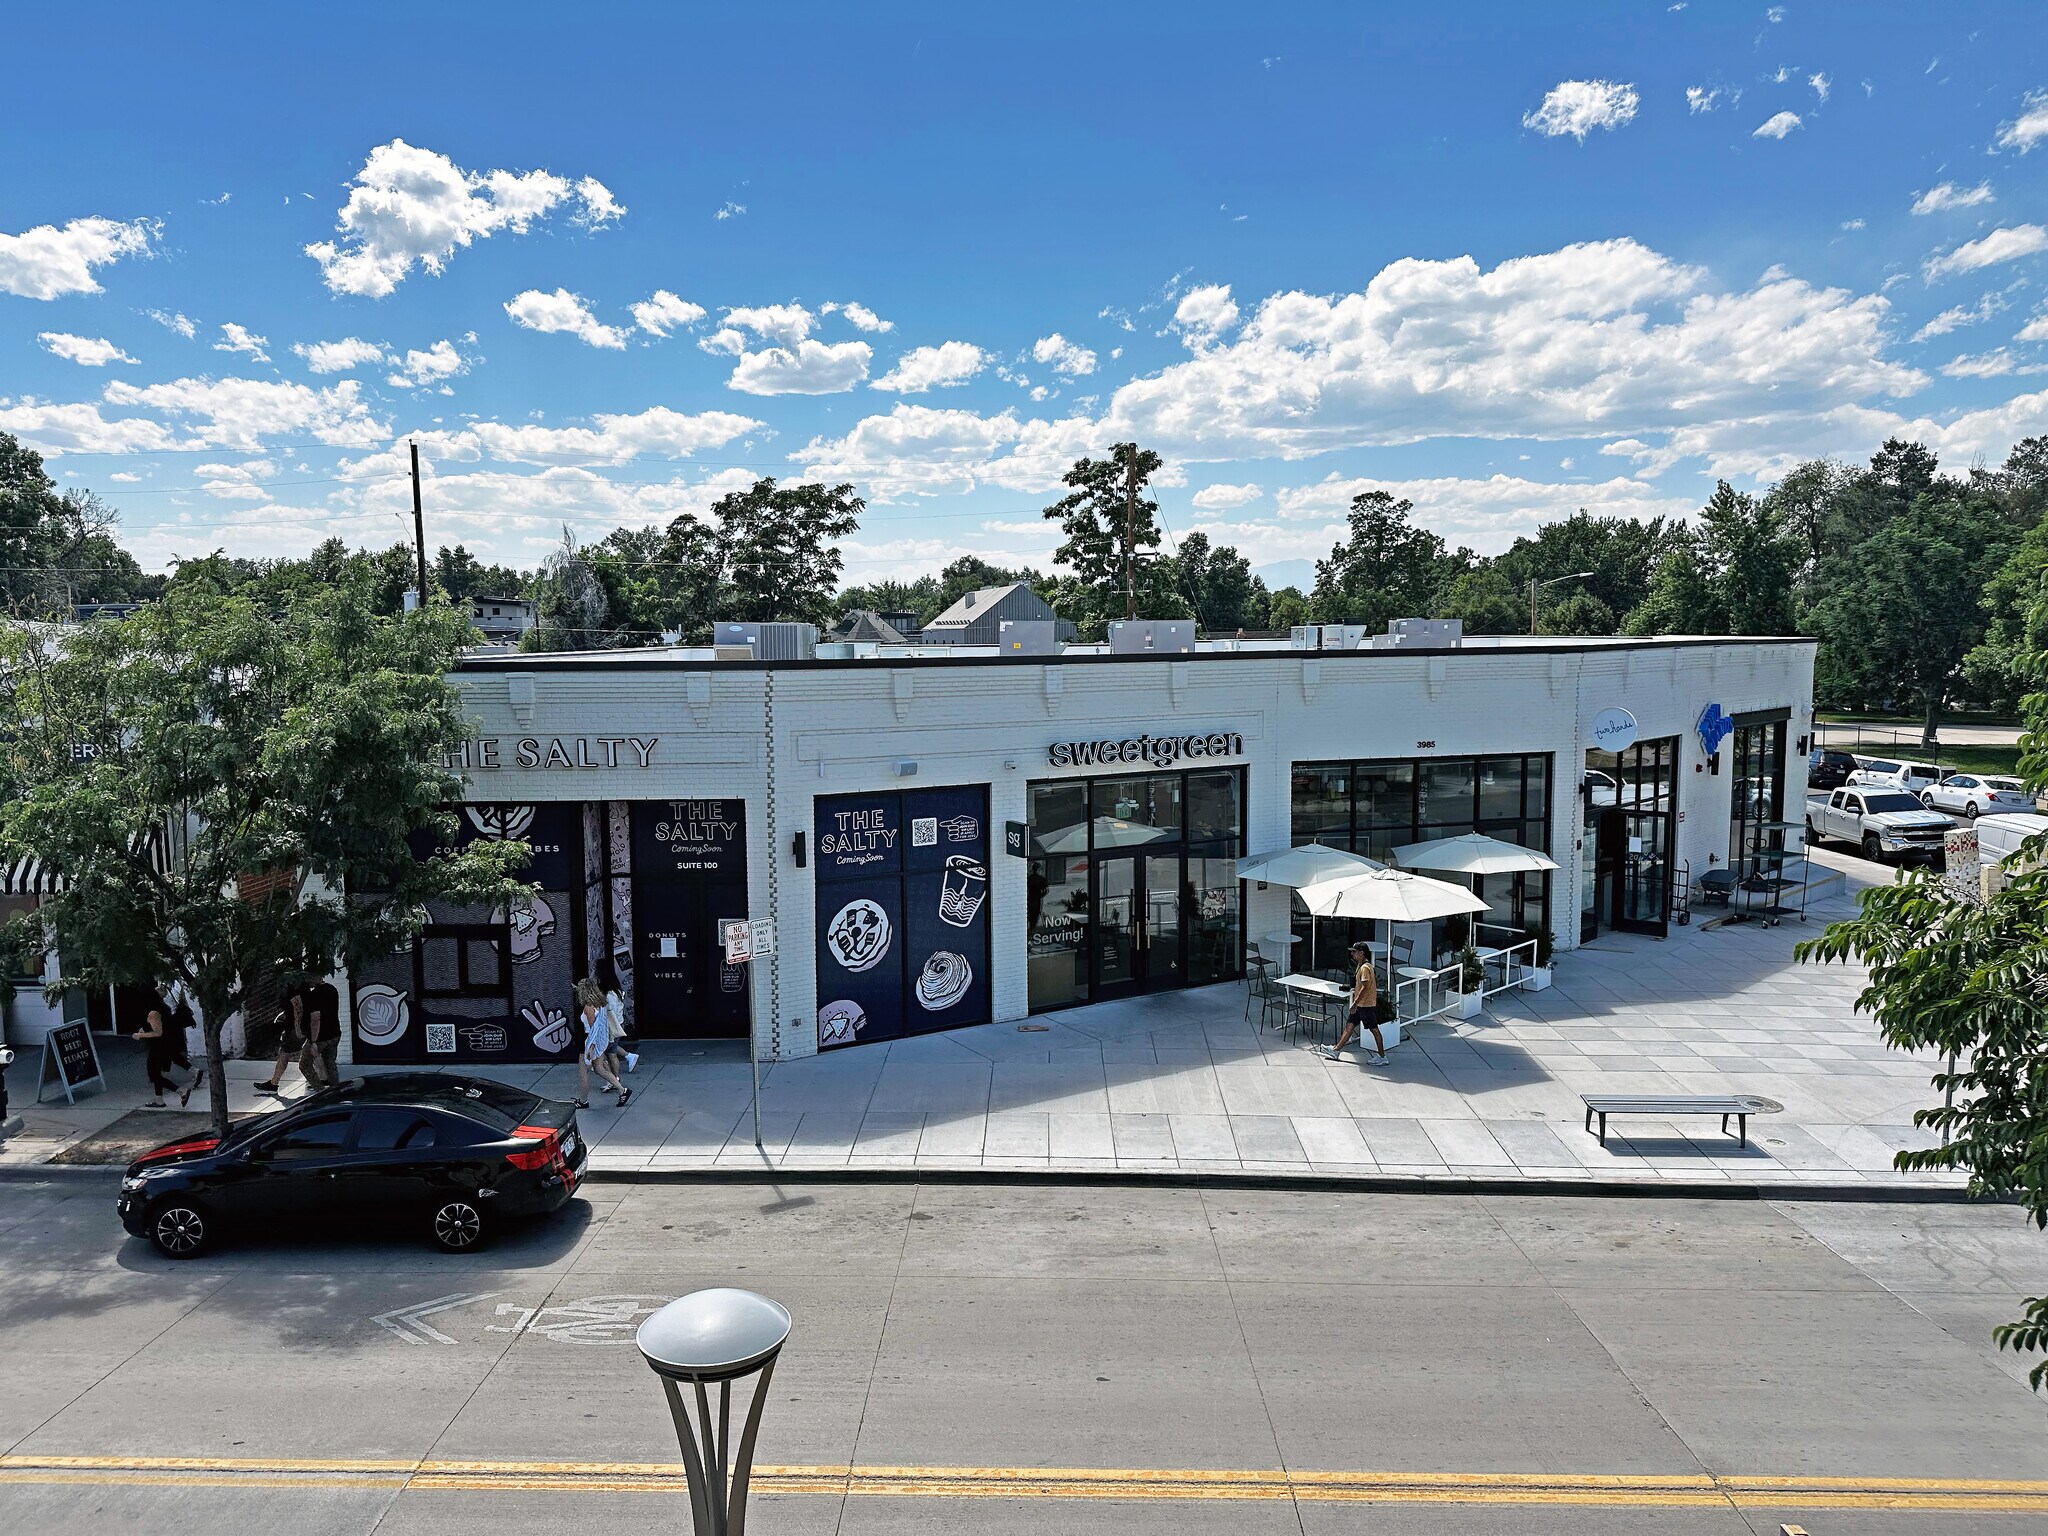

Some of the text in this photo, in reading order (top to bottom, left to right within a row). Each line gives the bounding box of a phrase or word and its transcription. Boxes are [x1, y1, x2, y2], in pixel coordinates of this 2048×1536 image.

[1049, 732, 1244, 768] sweetgreen
[1416, 740, 1436, 749] 3985
[440, 737, 659, 768] HE SALTY
[668, 801, 723, 820] THE
[834, 809, 885, 832] THE
[655, 821, 738, 841] SALTY
[821, 828, 898, 854] SALTY
[1008, 831, 1021, 848] sg
[671, 843, 724, 856] Coming Soon
[677, 862, 702, 870] SUITE
[836, 853, 885, 866] Coming Soon
[752, 920, 772, 930] LOADING
[1045, 915, 1071, 928] Now
[733, 925, 743, 934] NO
[1033, 927, 1084, 945] Serving!
[728, 931, 749, 943] PARKING
[60, 1028, 80, 1040] ROOT
[64, 1040, 83, 1052] BEER
[63, 1049, 89, 1065] FLOATS
